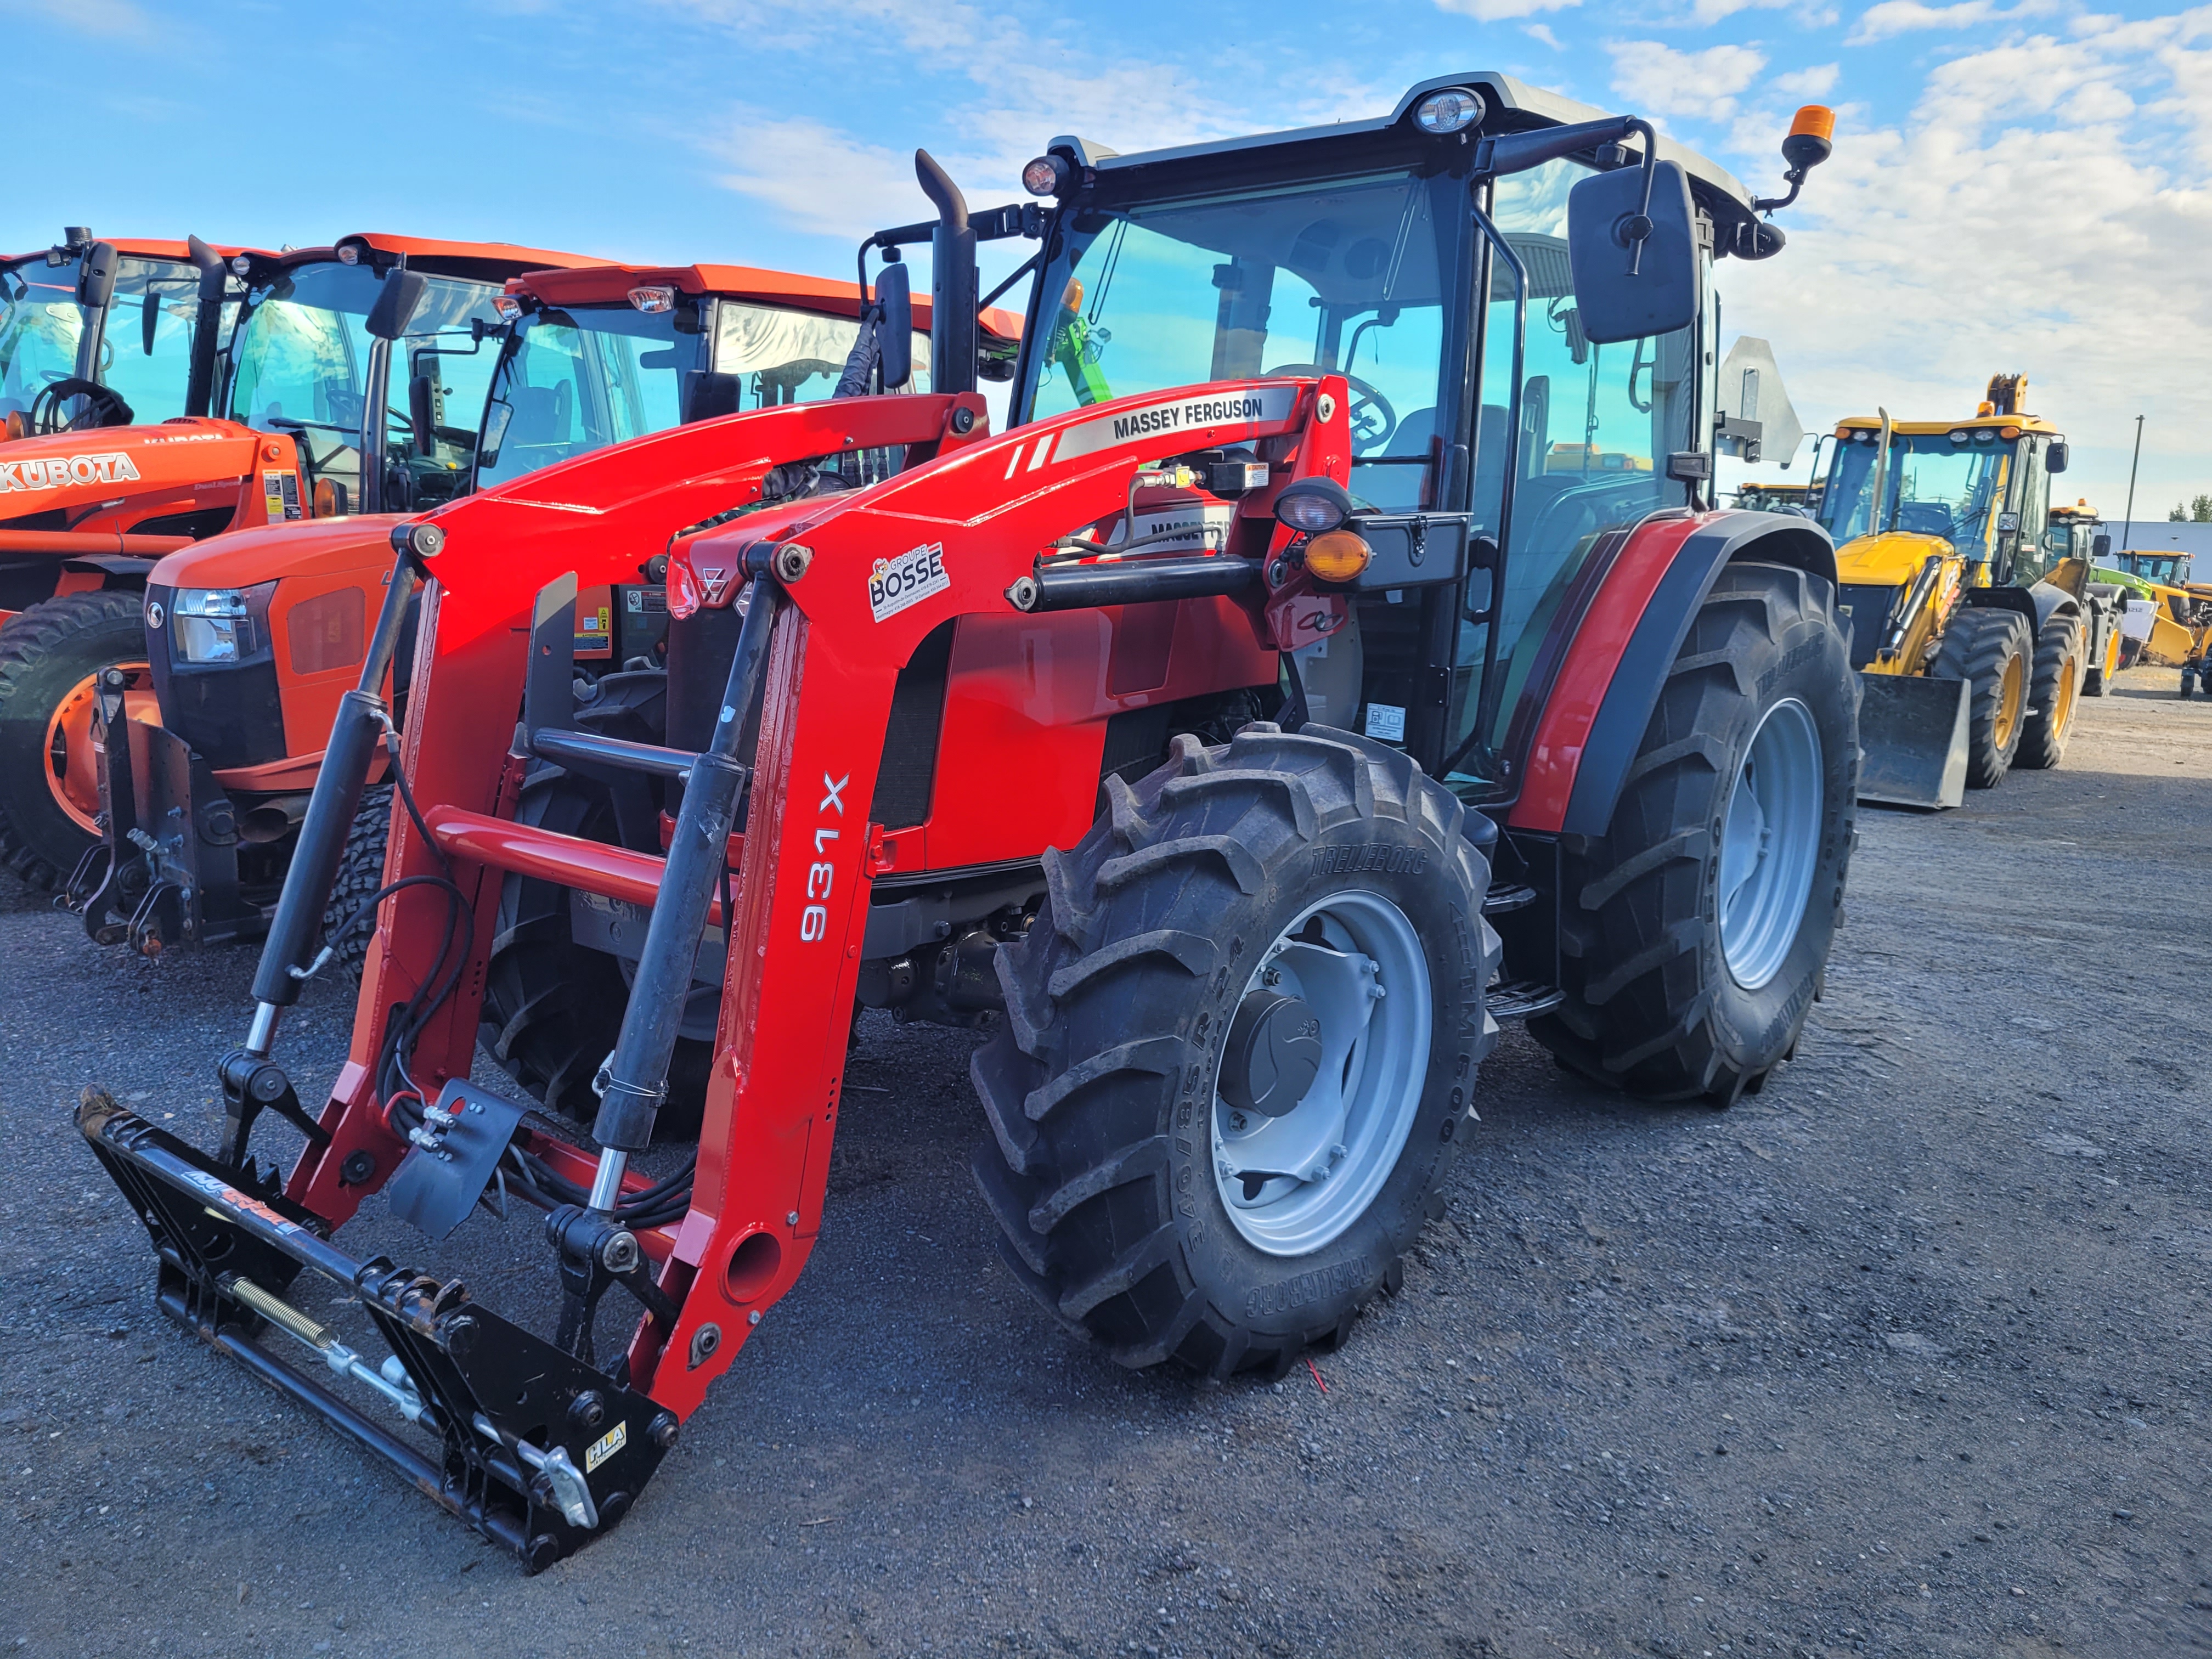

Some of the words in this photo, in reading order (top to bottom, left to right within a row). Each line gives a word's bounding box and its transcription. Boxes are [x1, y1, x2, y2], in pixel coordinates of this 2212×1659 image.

[1114, 407, 1179, 439] MASSEY
[1185, 398, 1262, 424] FERGUSON
[0, 454, 138, 491] KUBOTA
[890, 546, 927, 570] GROUPE
[870, 550, 943, 607] BOSSE
[1312, 842, 1429, 877] TRELLEBORG
[1246, 1255, 1373, 1318] TRELLEBORG
[590, 1427, 624, 1464] HLA
